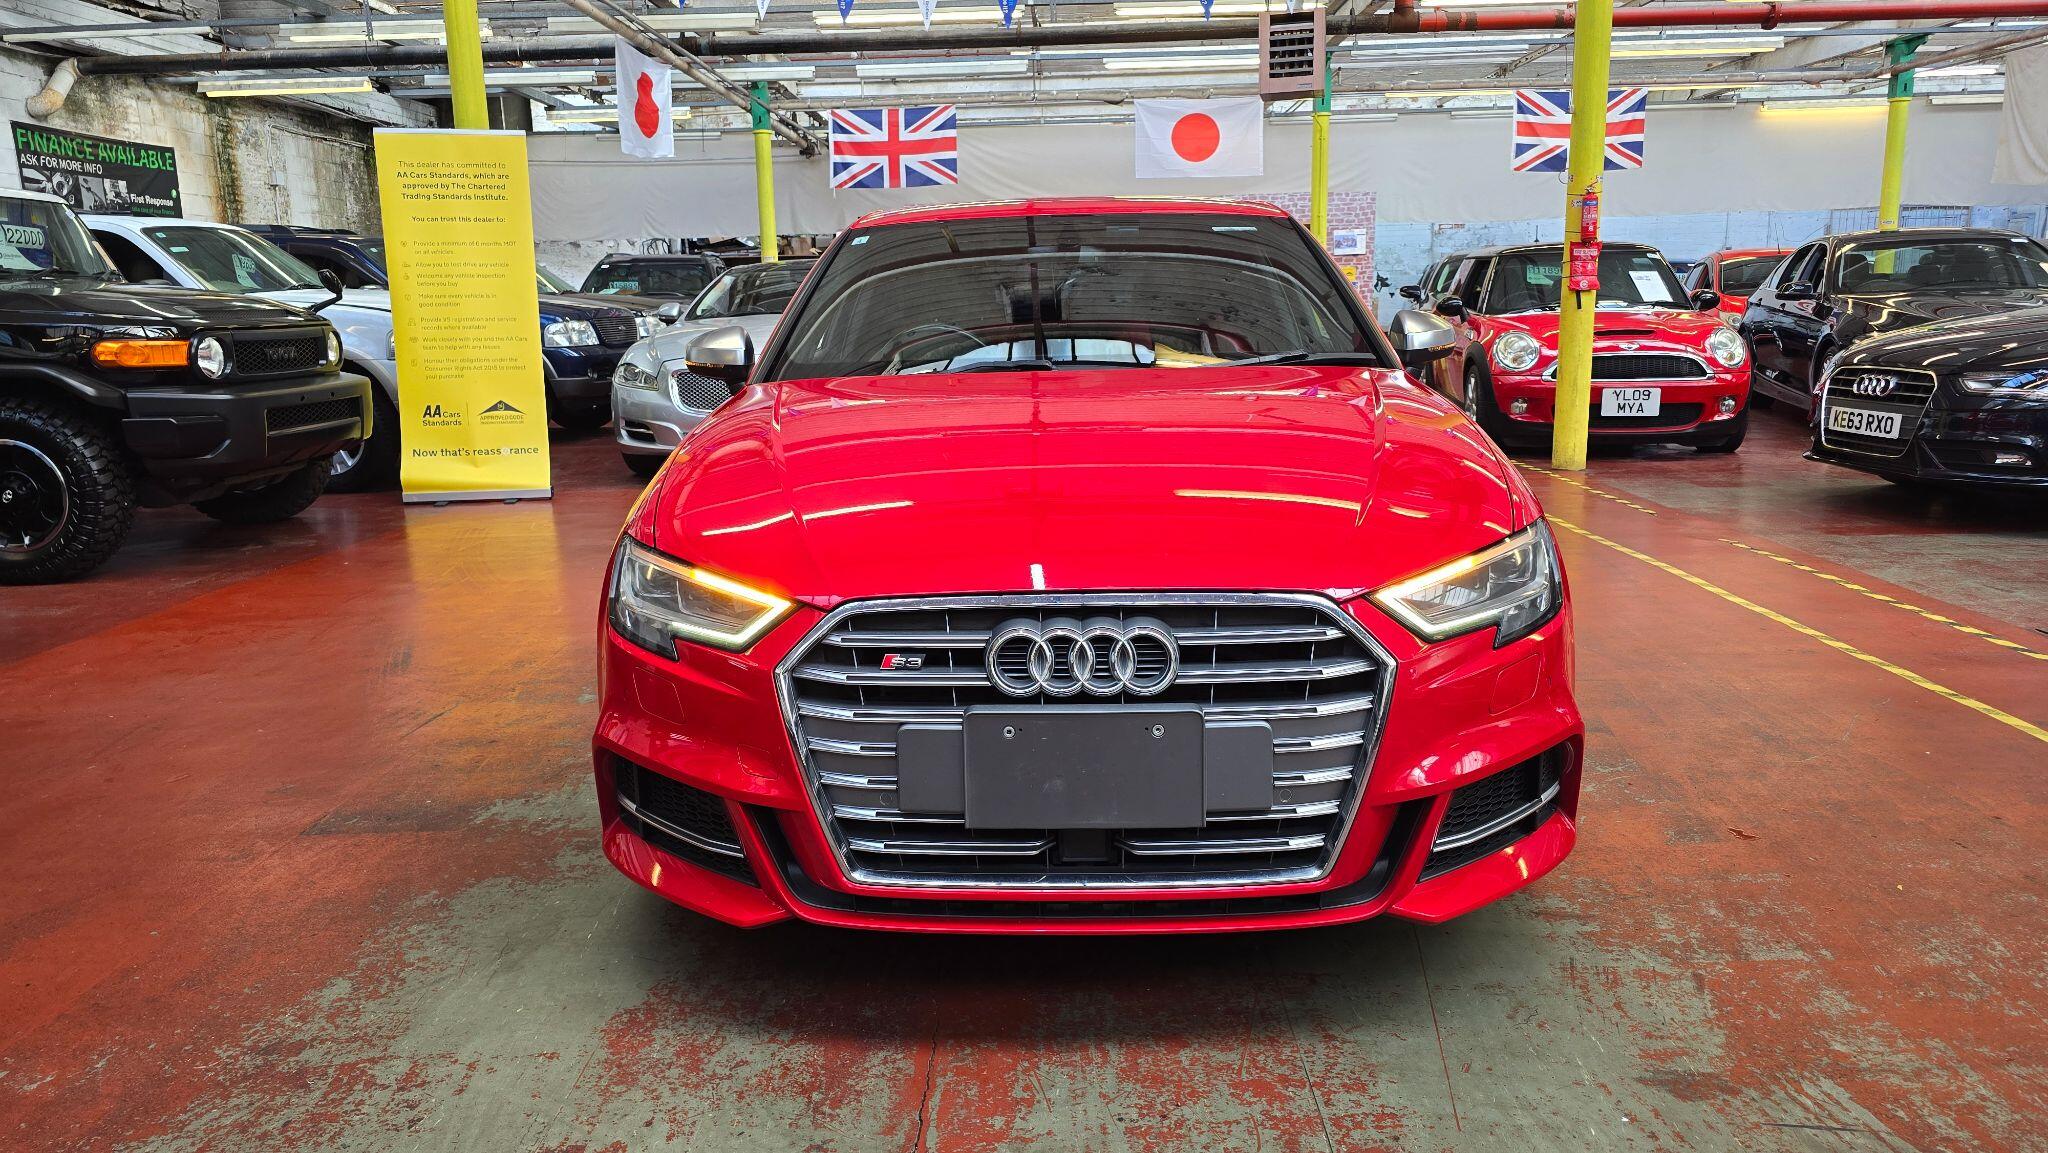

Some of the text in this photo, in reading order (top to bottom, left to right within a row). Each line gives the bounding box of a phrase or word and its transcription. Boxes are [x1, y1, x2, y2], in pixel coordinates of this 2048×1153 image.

[16, 128, 174, 171] FINANCE AVAILABLE
[20, 153, 102, 174] ASK FOR MORE INFO
[130, 194, 173, 206] First Response
[402, 193, 430, 201] Trading
[1614, 390, 1651, 401] YL09
[423, 404, 442, 418] AA
[1617, 403, 1644, 414] MYA
[1833, 410, 1894, 434] KE63 RXO
[412, 448, 539, 457] Now that's reassrance
